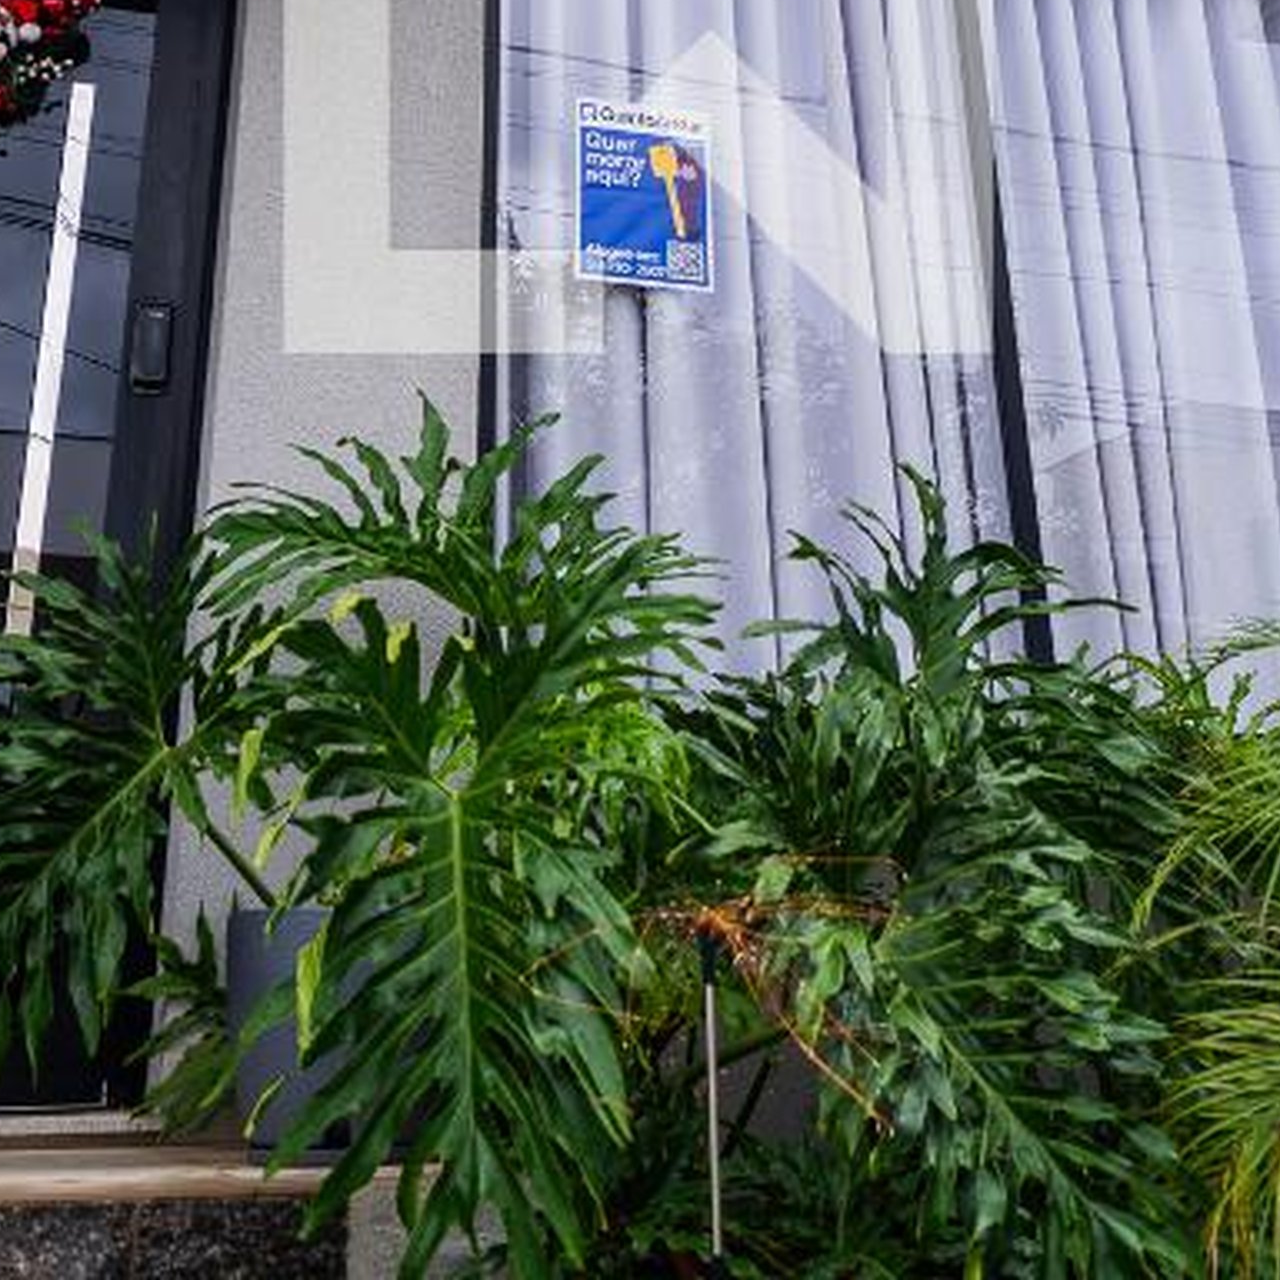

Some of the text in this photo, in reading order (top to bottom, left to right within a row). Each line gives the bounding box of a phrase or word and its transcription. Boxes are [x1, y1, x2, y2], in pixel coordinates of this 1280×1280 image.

[585, 131, 639, 152] Quer
[585, 152, 647, 171] morar
[585, 169, 642, 189] aqui?
